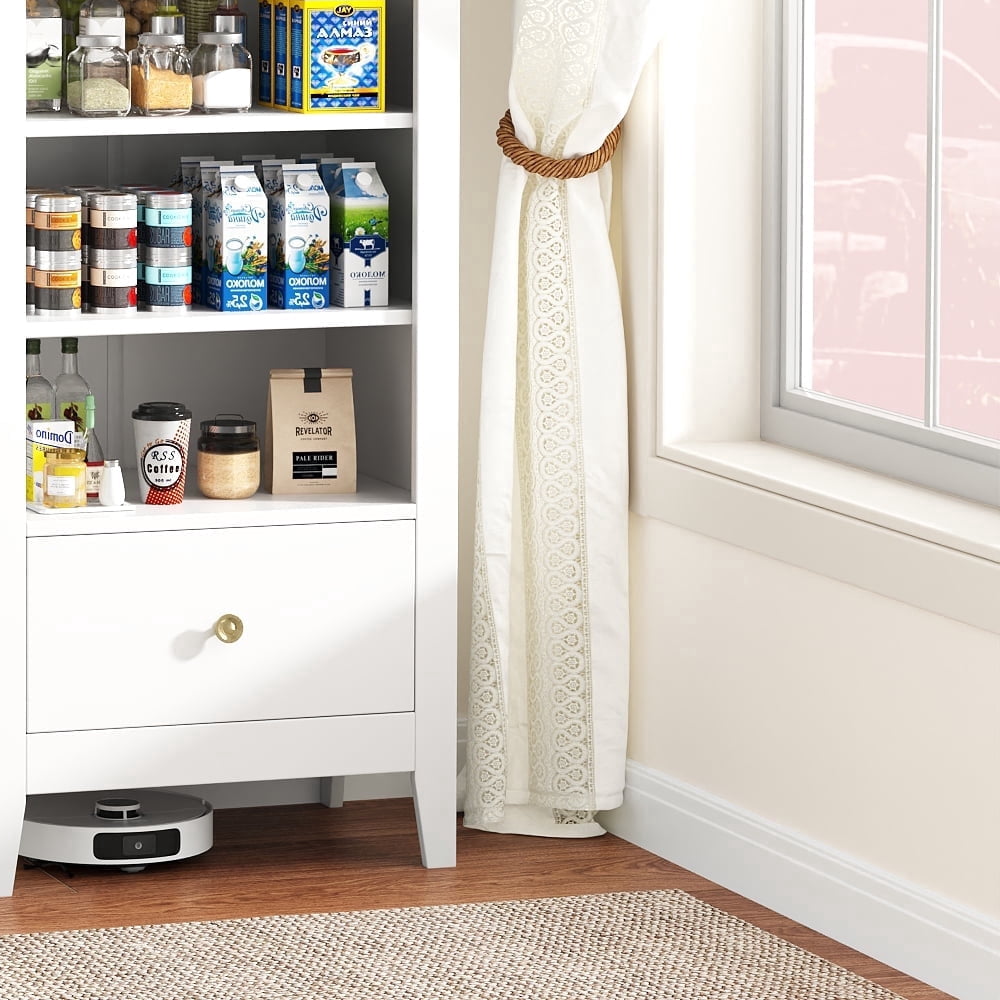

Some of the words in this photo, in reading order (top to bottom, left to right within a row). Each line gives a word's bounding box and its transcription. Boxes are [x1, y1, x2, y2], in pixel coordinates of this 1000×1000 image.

[316, 27, 373, 39] АЛМАЗ
[296, 426, 332, 436] REVELATOR
[147, 464, 179, 473] Coffee
